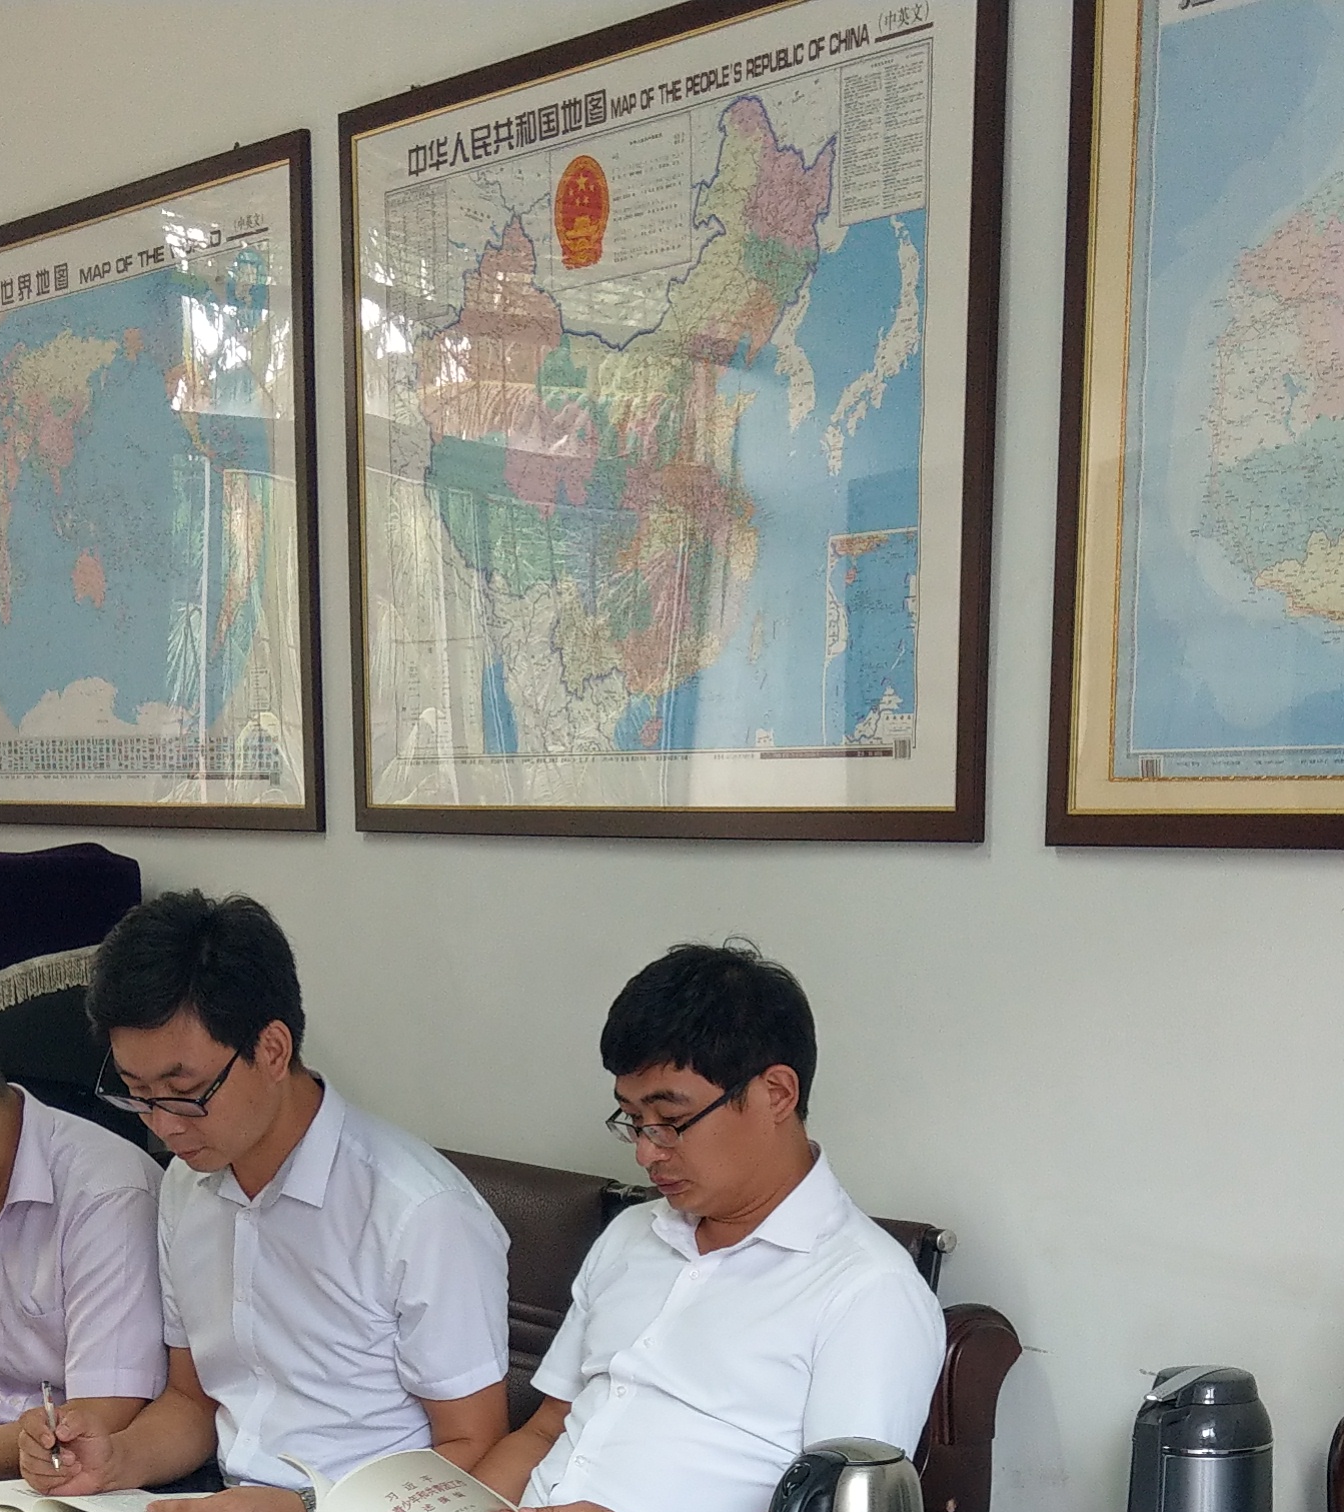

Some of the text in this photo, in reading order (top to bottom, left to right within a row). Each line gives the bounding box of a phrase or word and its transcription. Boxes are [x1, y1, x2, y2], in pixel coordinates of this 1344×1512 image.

[408, 89, 606, 177] 中华人民共和国地图
[611, 92, 637, 119] MAP
[640, 87, 654, 110] OF
[658, 79, 682, 104] THE
[686, 61, 742, 98] PEOPLE'S
[746, 43, 804, 80] REPUBLIC
[808, 36, 825, 61] OF
[829, 23, 870, 55] CHINA
[0, 262, 68, 306] 世界地图
[79, 261, 111, 285] MAP
[115, 255, 133, 274] OF
[137, 245, 165, 268] THE
